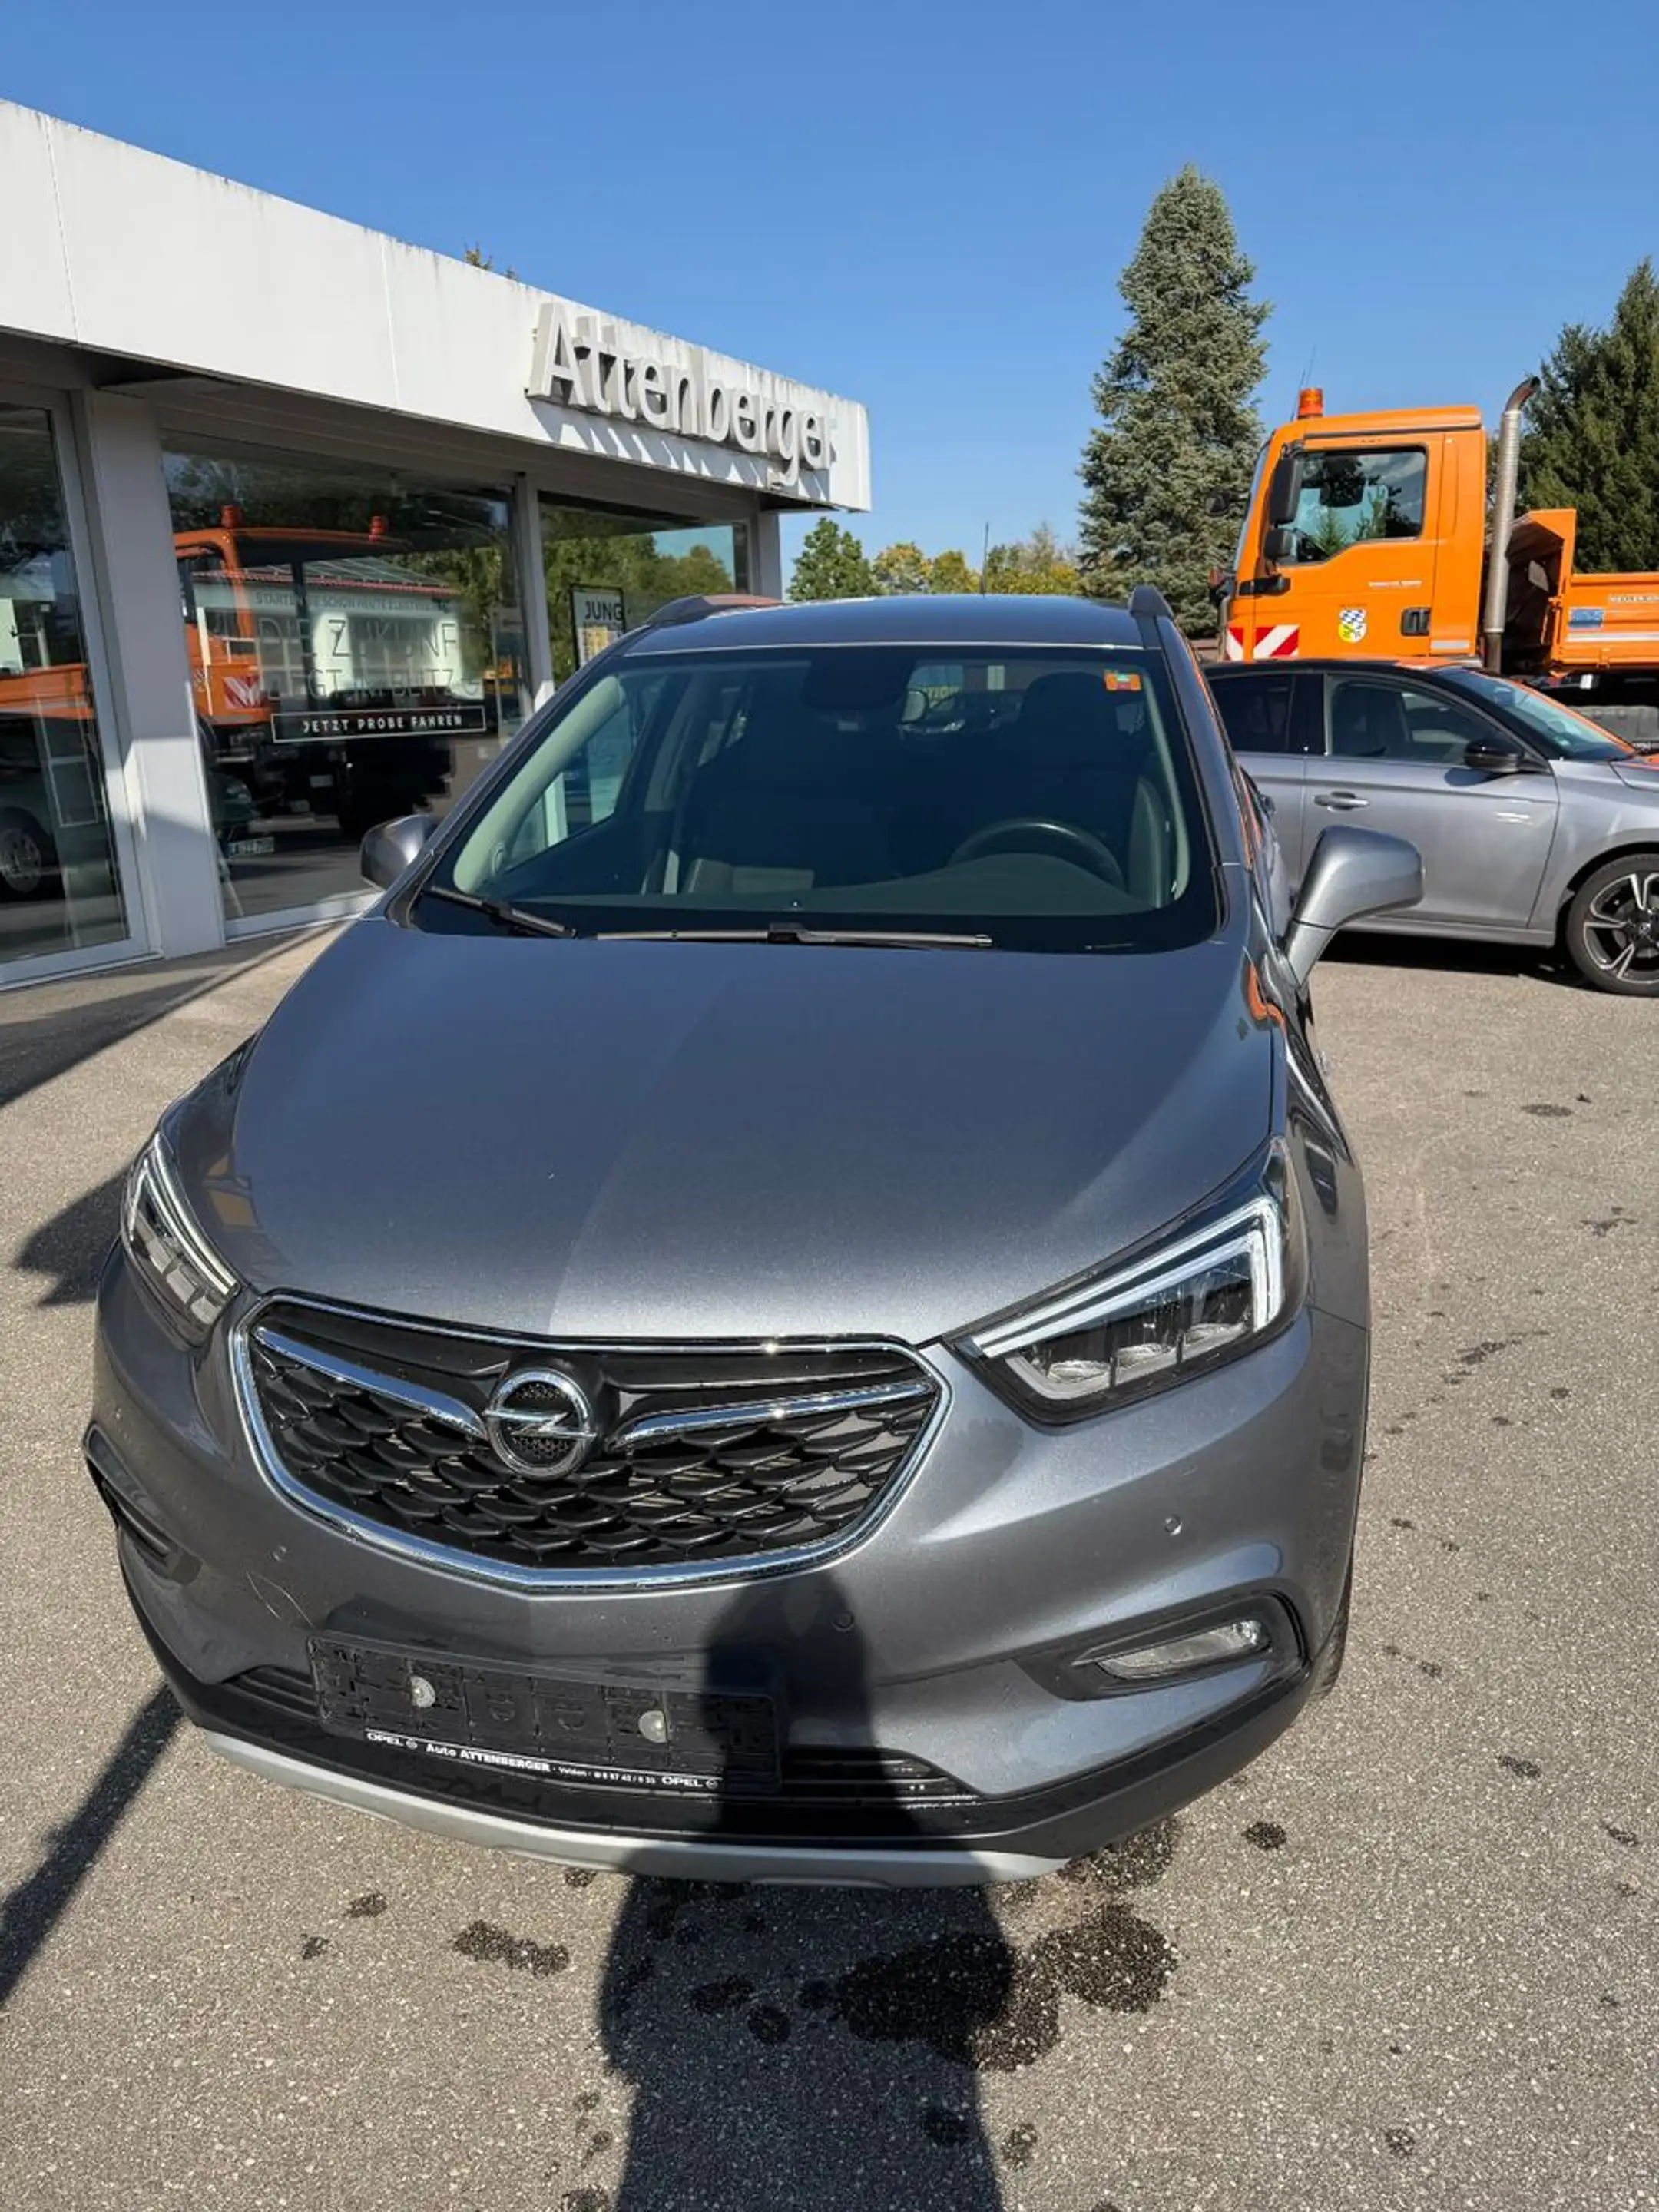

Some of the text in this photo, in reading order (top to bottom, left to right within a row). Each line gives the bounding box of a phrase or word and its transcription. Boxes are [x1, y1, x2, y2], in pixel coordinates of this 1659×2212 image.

[529, 302, 834, 487] Attenberger
[303, 714, 462, 733] JETZT PROBE FAHREN
[366, 1732, 404, 1747] OPEL
[426, 1743, 456, 1757] Auto
[460, 1750, 551, 1773] ATTENBERGER
[661, 1776, 704, 1788] OPEL
